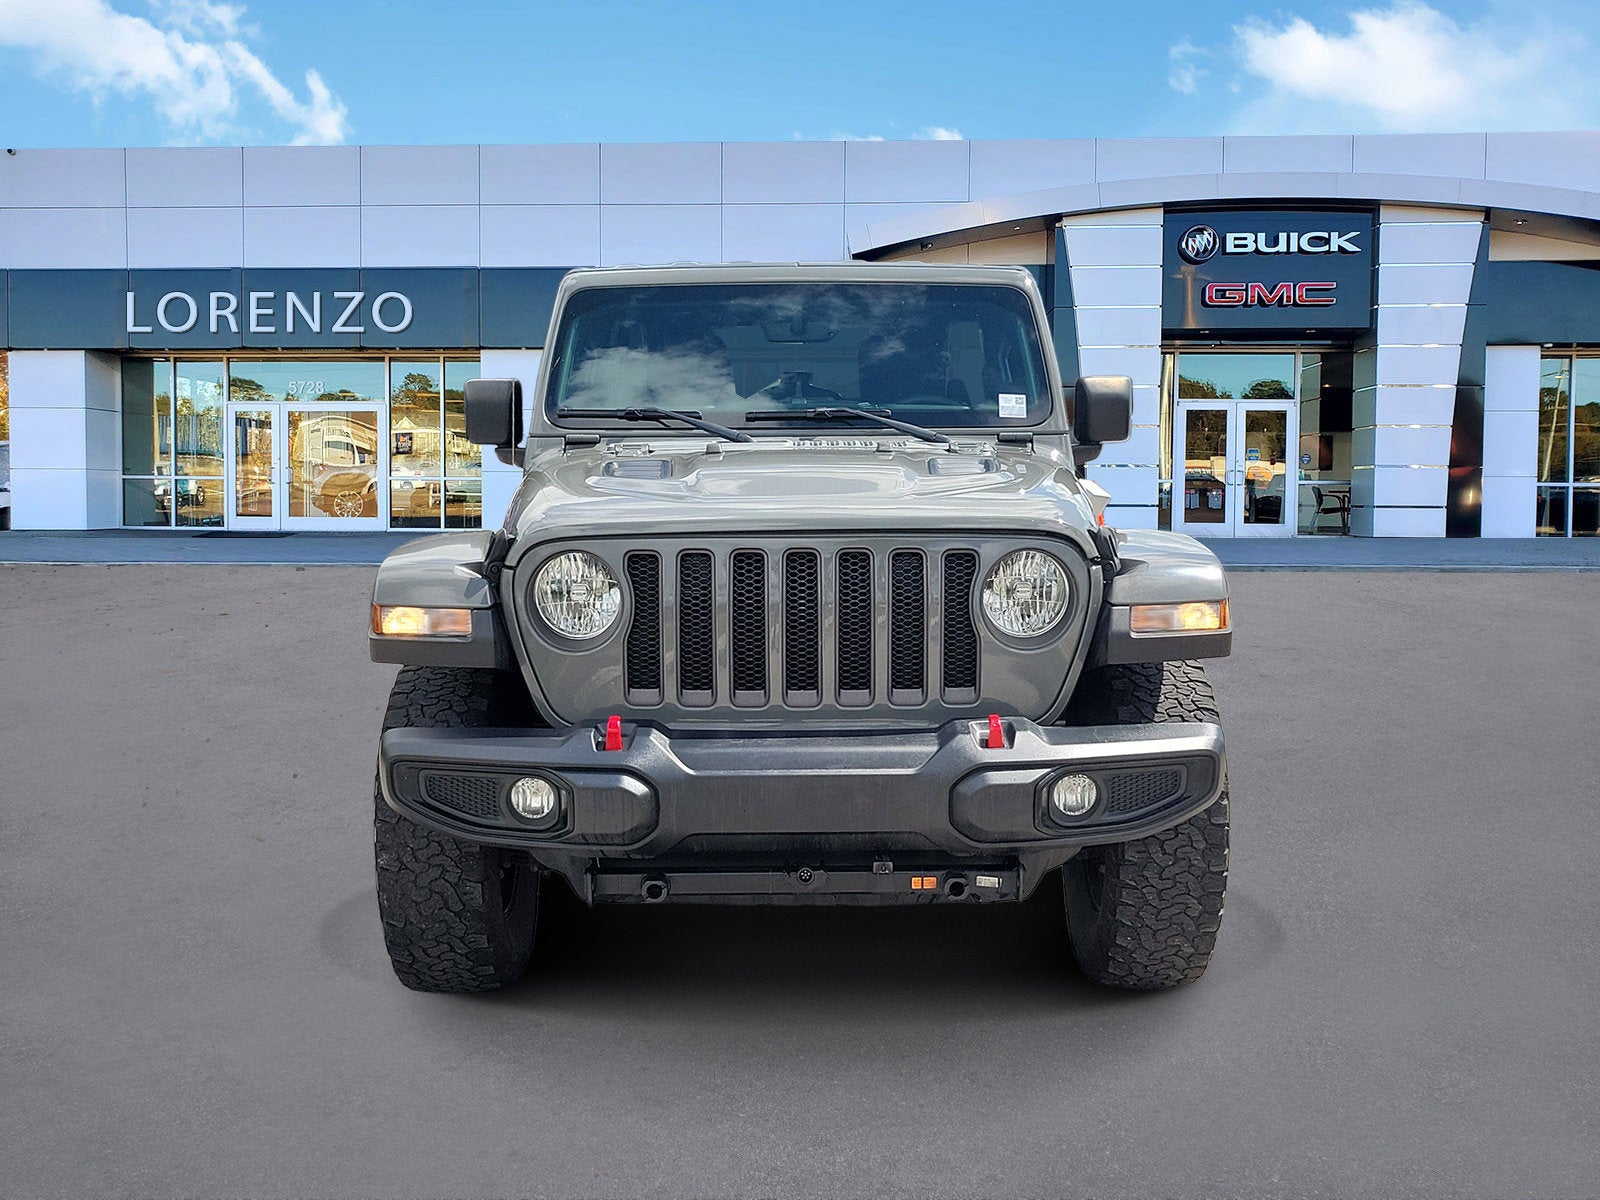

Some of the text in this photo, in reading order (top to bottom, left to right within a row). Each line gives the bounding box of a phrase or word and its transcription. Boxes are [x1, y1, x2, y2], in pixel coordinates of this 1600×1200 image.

[1225, 231, 1362, 253] BUICK
[1205, 281, 1337, 305] GMC
[126, 291, 413, 333] LORENZO
[288, 380, 325, 394] 5728
